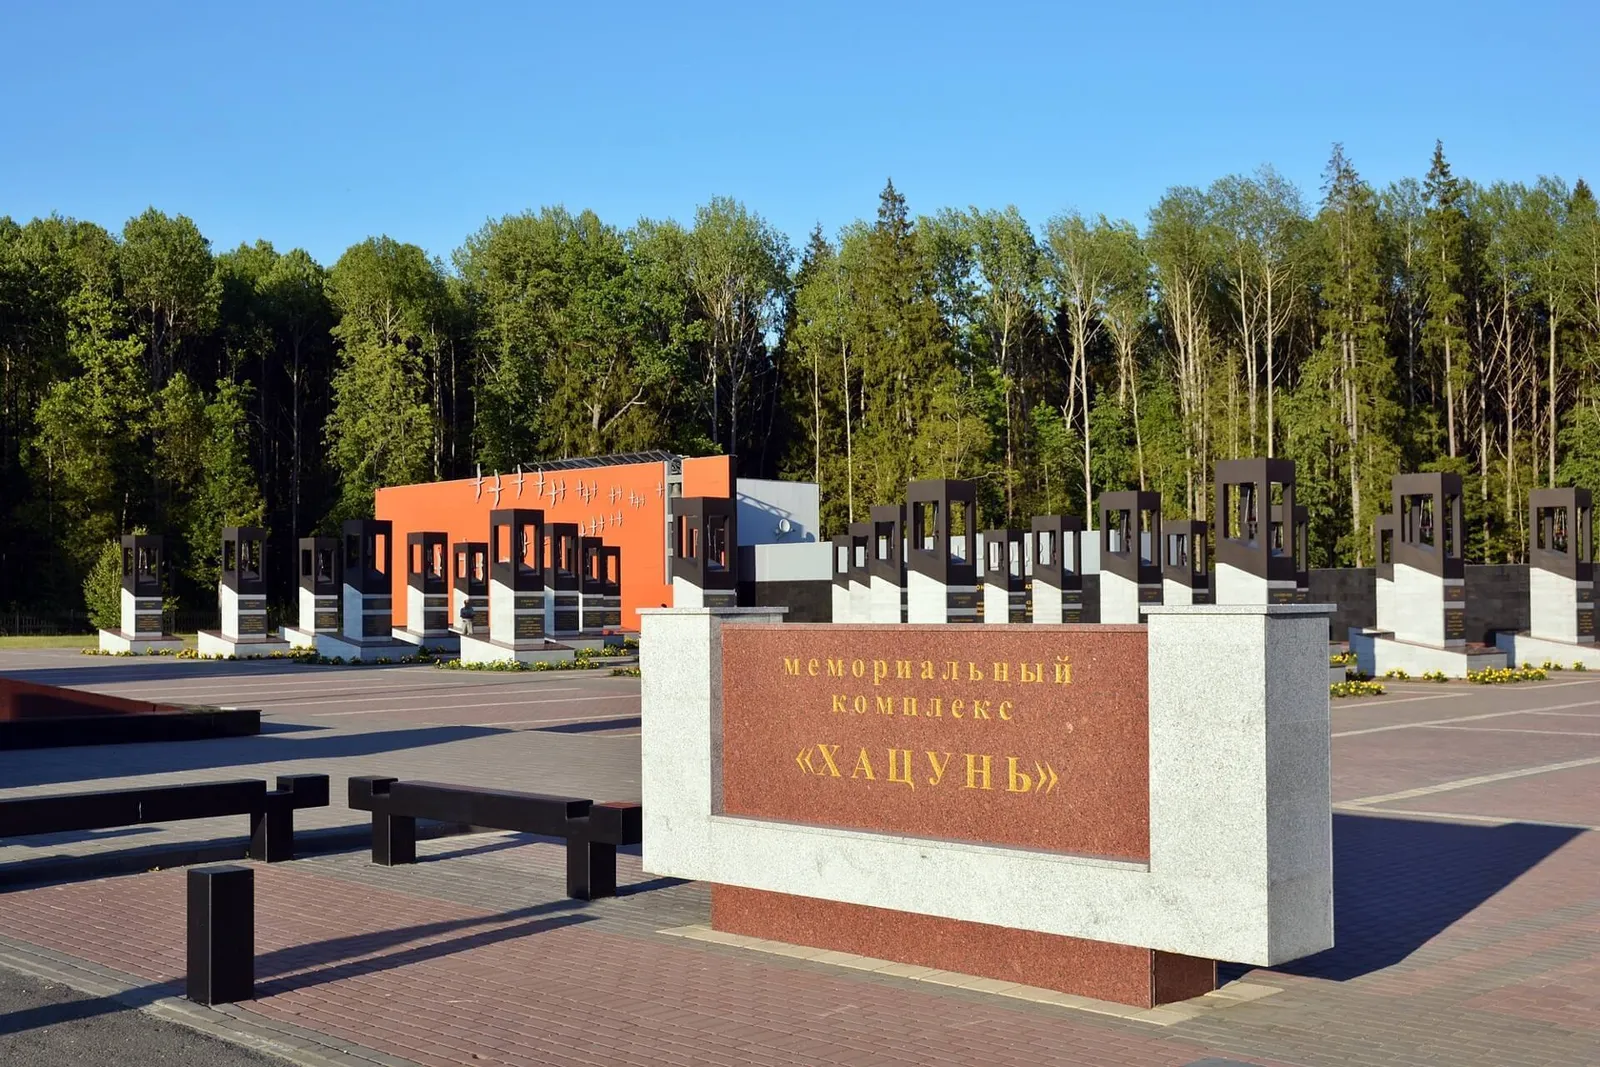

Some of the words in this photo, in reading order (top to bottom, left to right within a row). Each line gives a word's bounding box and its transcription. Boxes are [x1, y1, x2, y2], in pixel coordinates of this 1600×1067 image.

[784, 655, 1073, 685] мемориальный
[831, 693, 1014, 720] комплекс
[795, 744, 1060, 794] «ХАЦУНЬ»
